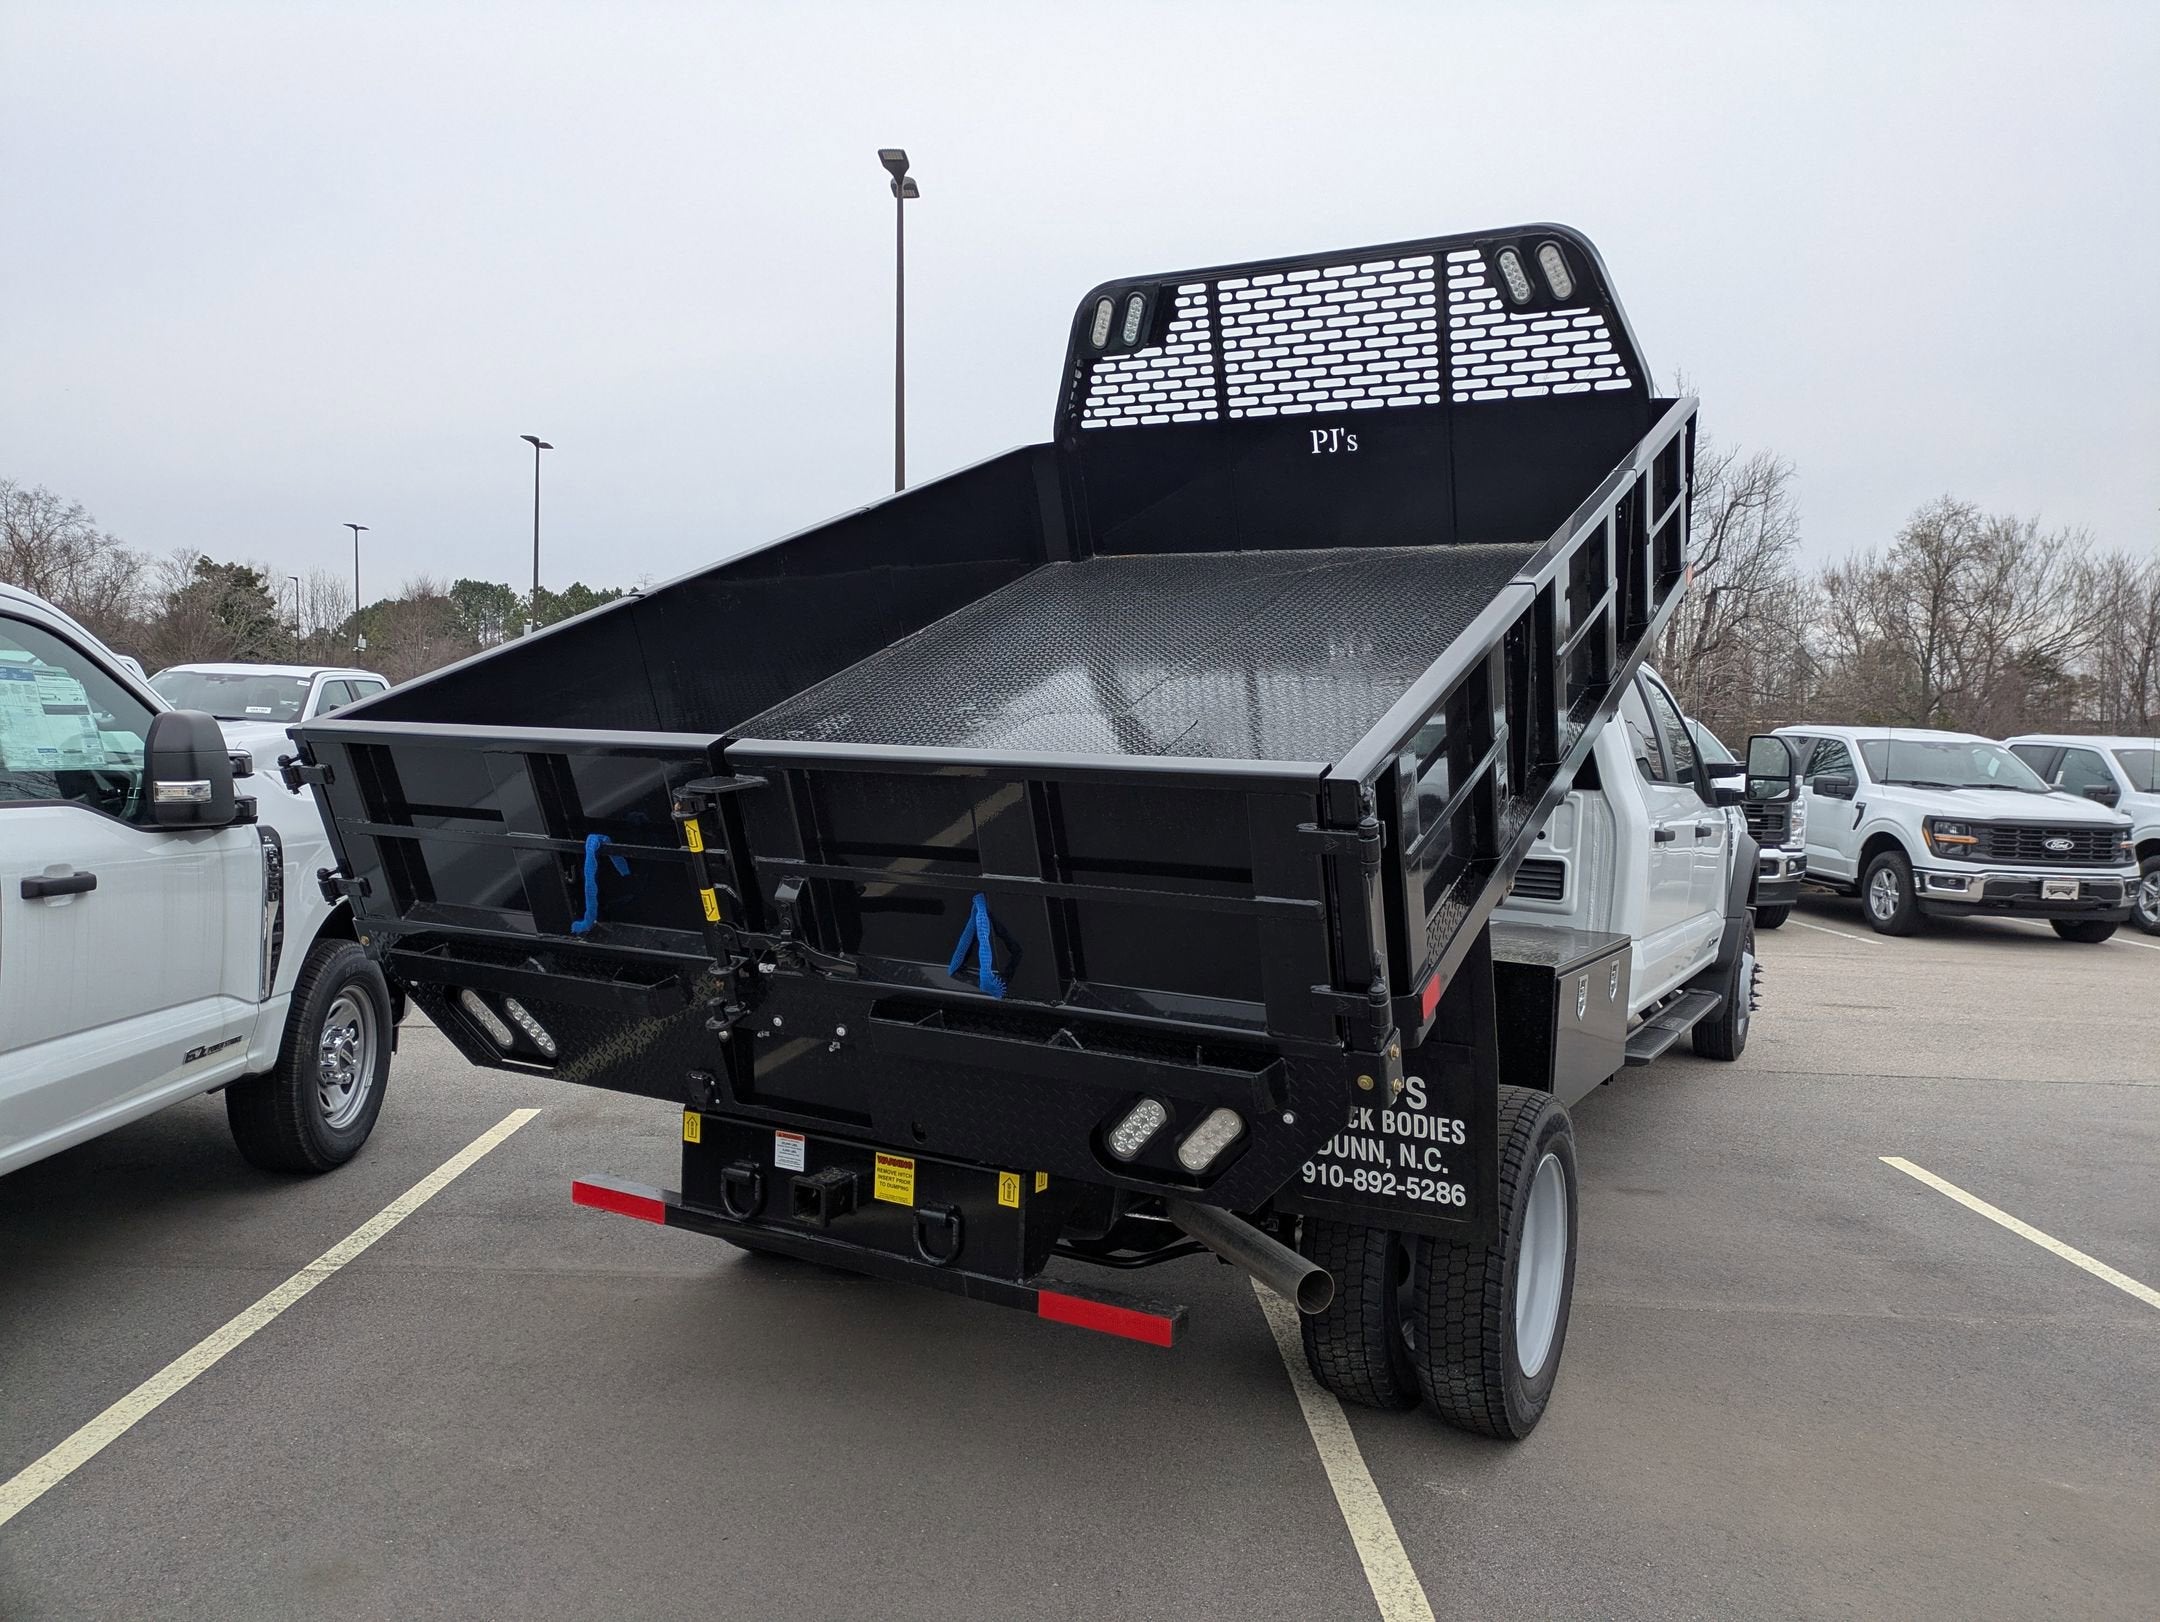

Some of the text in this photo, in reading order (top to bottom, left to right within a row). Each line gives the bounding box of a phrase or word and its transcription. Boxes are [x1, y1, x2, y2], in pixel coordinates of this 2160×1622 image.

[1310, 427, 1359, 454] PJ's
[2048, 839, 2070, 849] Ford
[1382, 1109, 1466, 1145] BODIES
[1399, 1143, 1449, 1174] N.C.
[877, 1167, 897, 1177] REMOVE
[877, 1174, 895, 1182] INSERT
[887, 1183, 909, 1191] DUMPING
[1302, 1161, 1467, 1207] 910-892-5286
